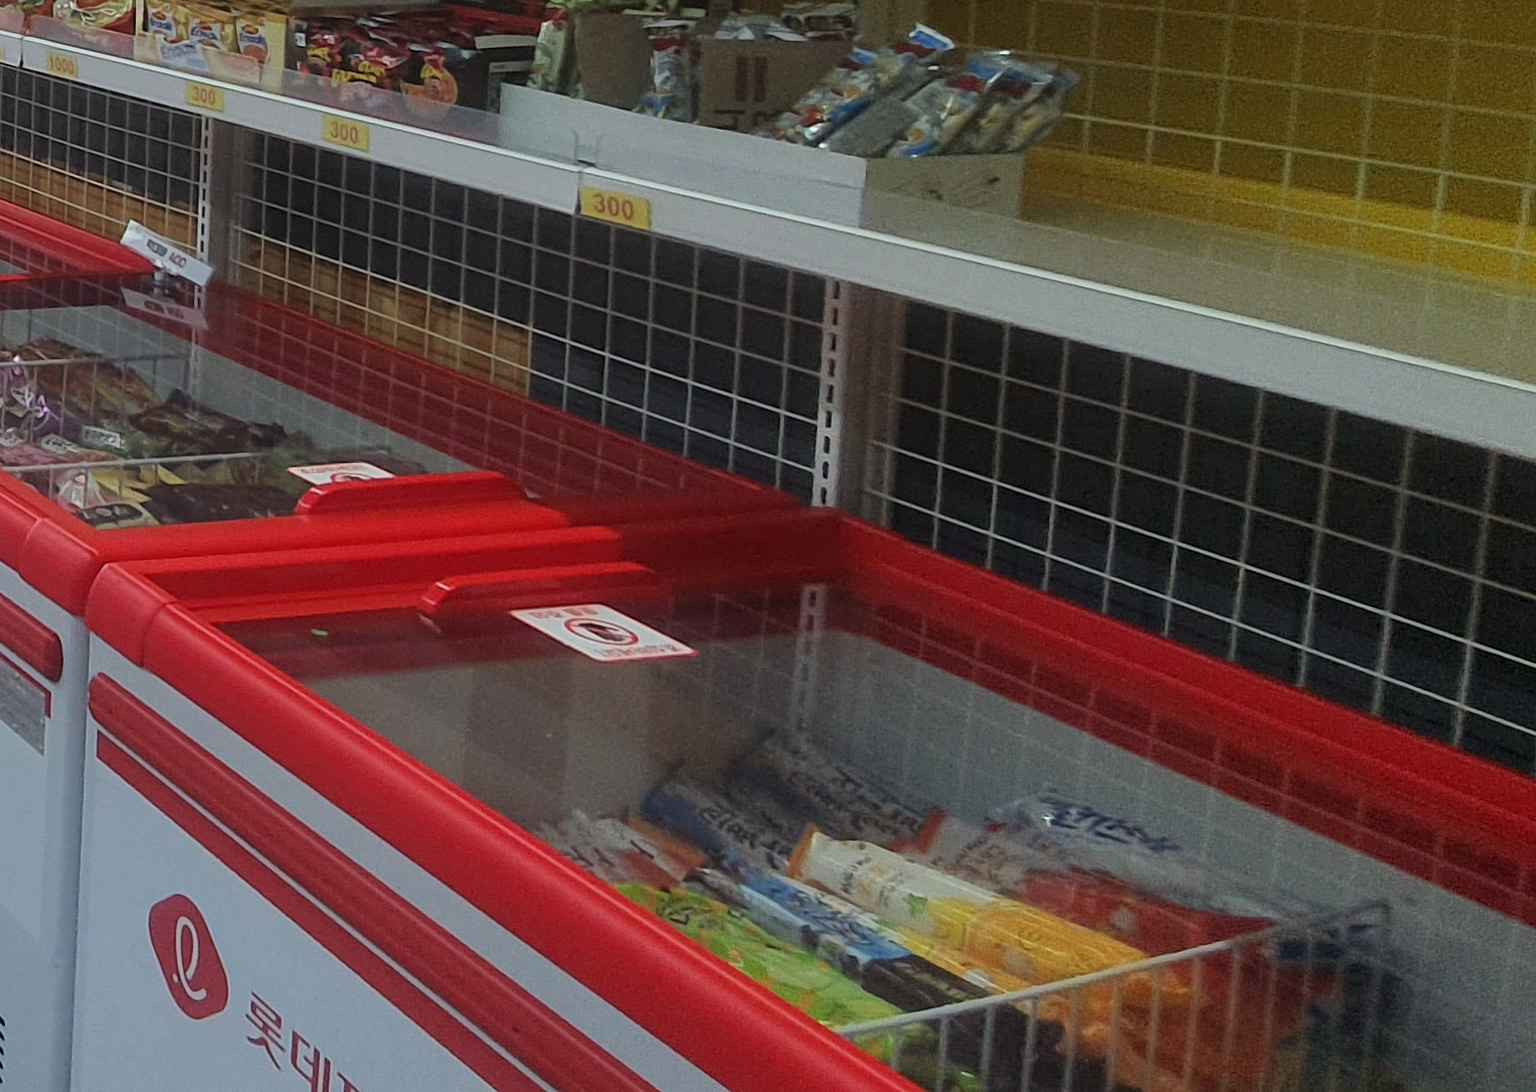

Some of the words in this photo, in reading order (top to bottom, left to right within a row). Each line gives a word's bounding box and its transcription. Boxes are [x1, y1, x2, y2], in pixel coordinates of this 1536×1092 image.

[47, 56, 75, 75] 1000
[192, 88, 216, 106] 300
[329, 122, 359, 144] 300
[592, 191, 635, 221] 300
[244, 991, 364, 1092] 롯데
